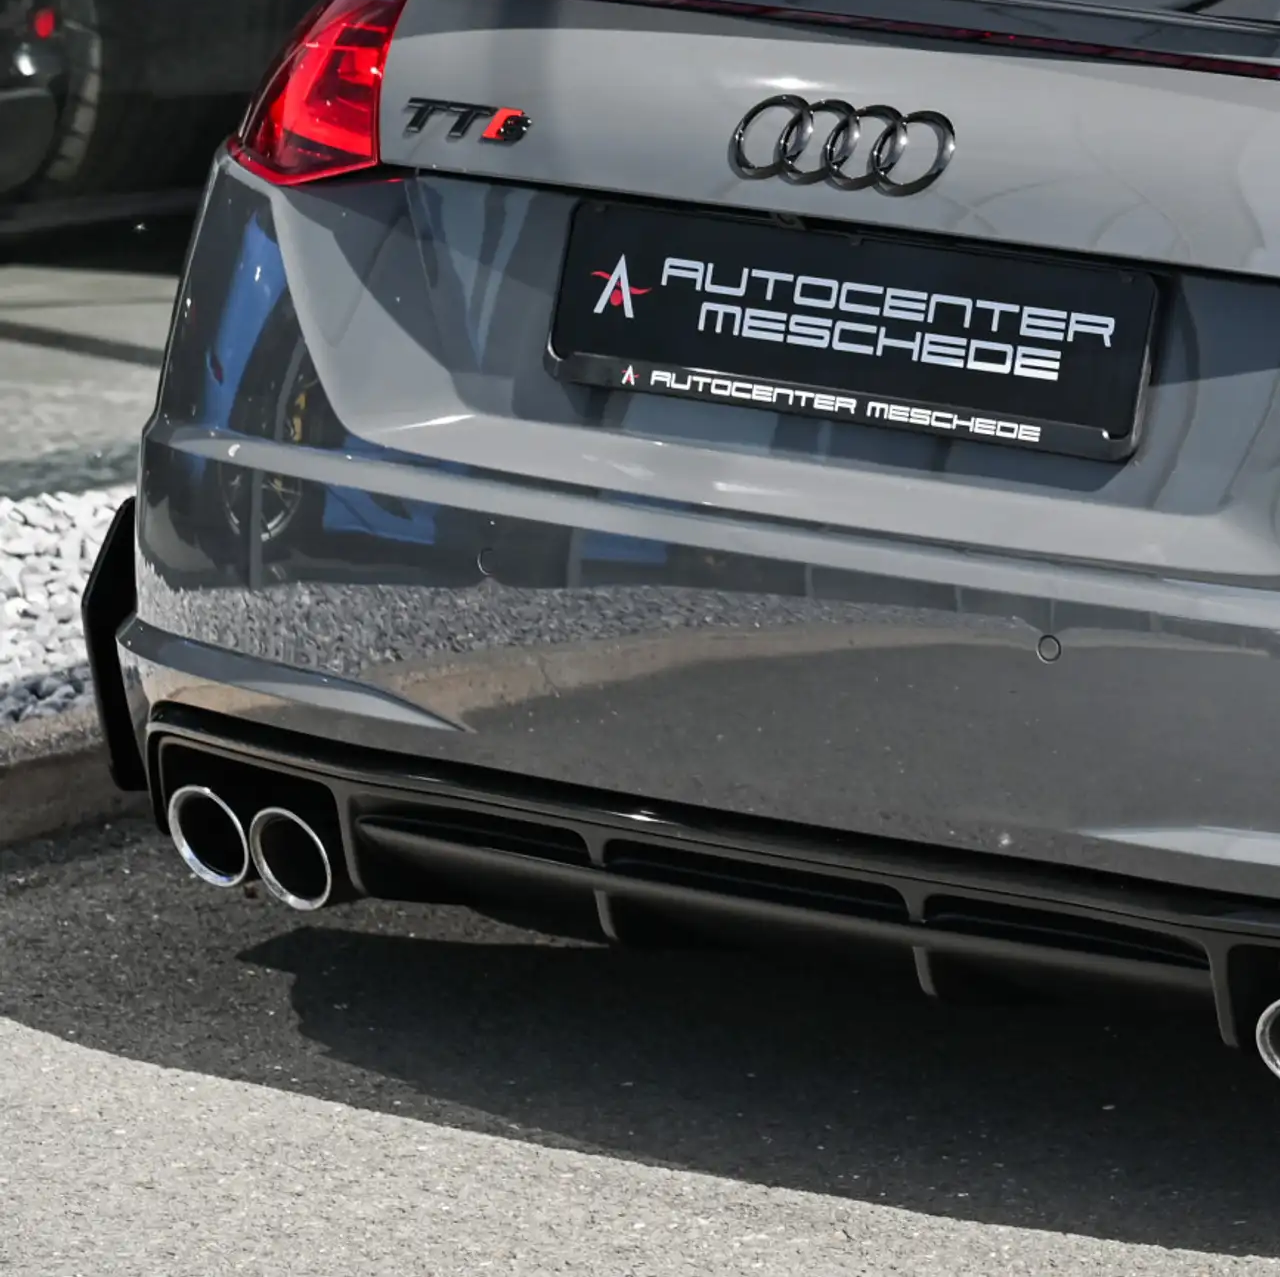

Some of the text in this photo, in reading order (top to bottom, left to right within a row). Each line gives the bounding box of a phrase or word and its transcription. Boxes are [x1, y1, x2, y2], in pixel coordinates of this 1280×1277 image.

[660, 257, 1116, 348] AUTOCENTER
[698, 302, 1062, 382] MESCHEDE
[650, 370, 1041, 443] AUTOCENTER MESCHEDE
